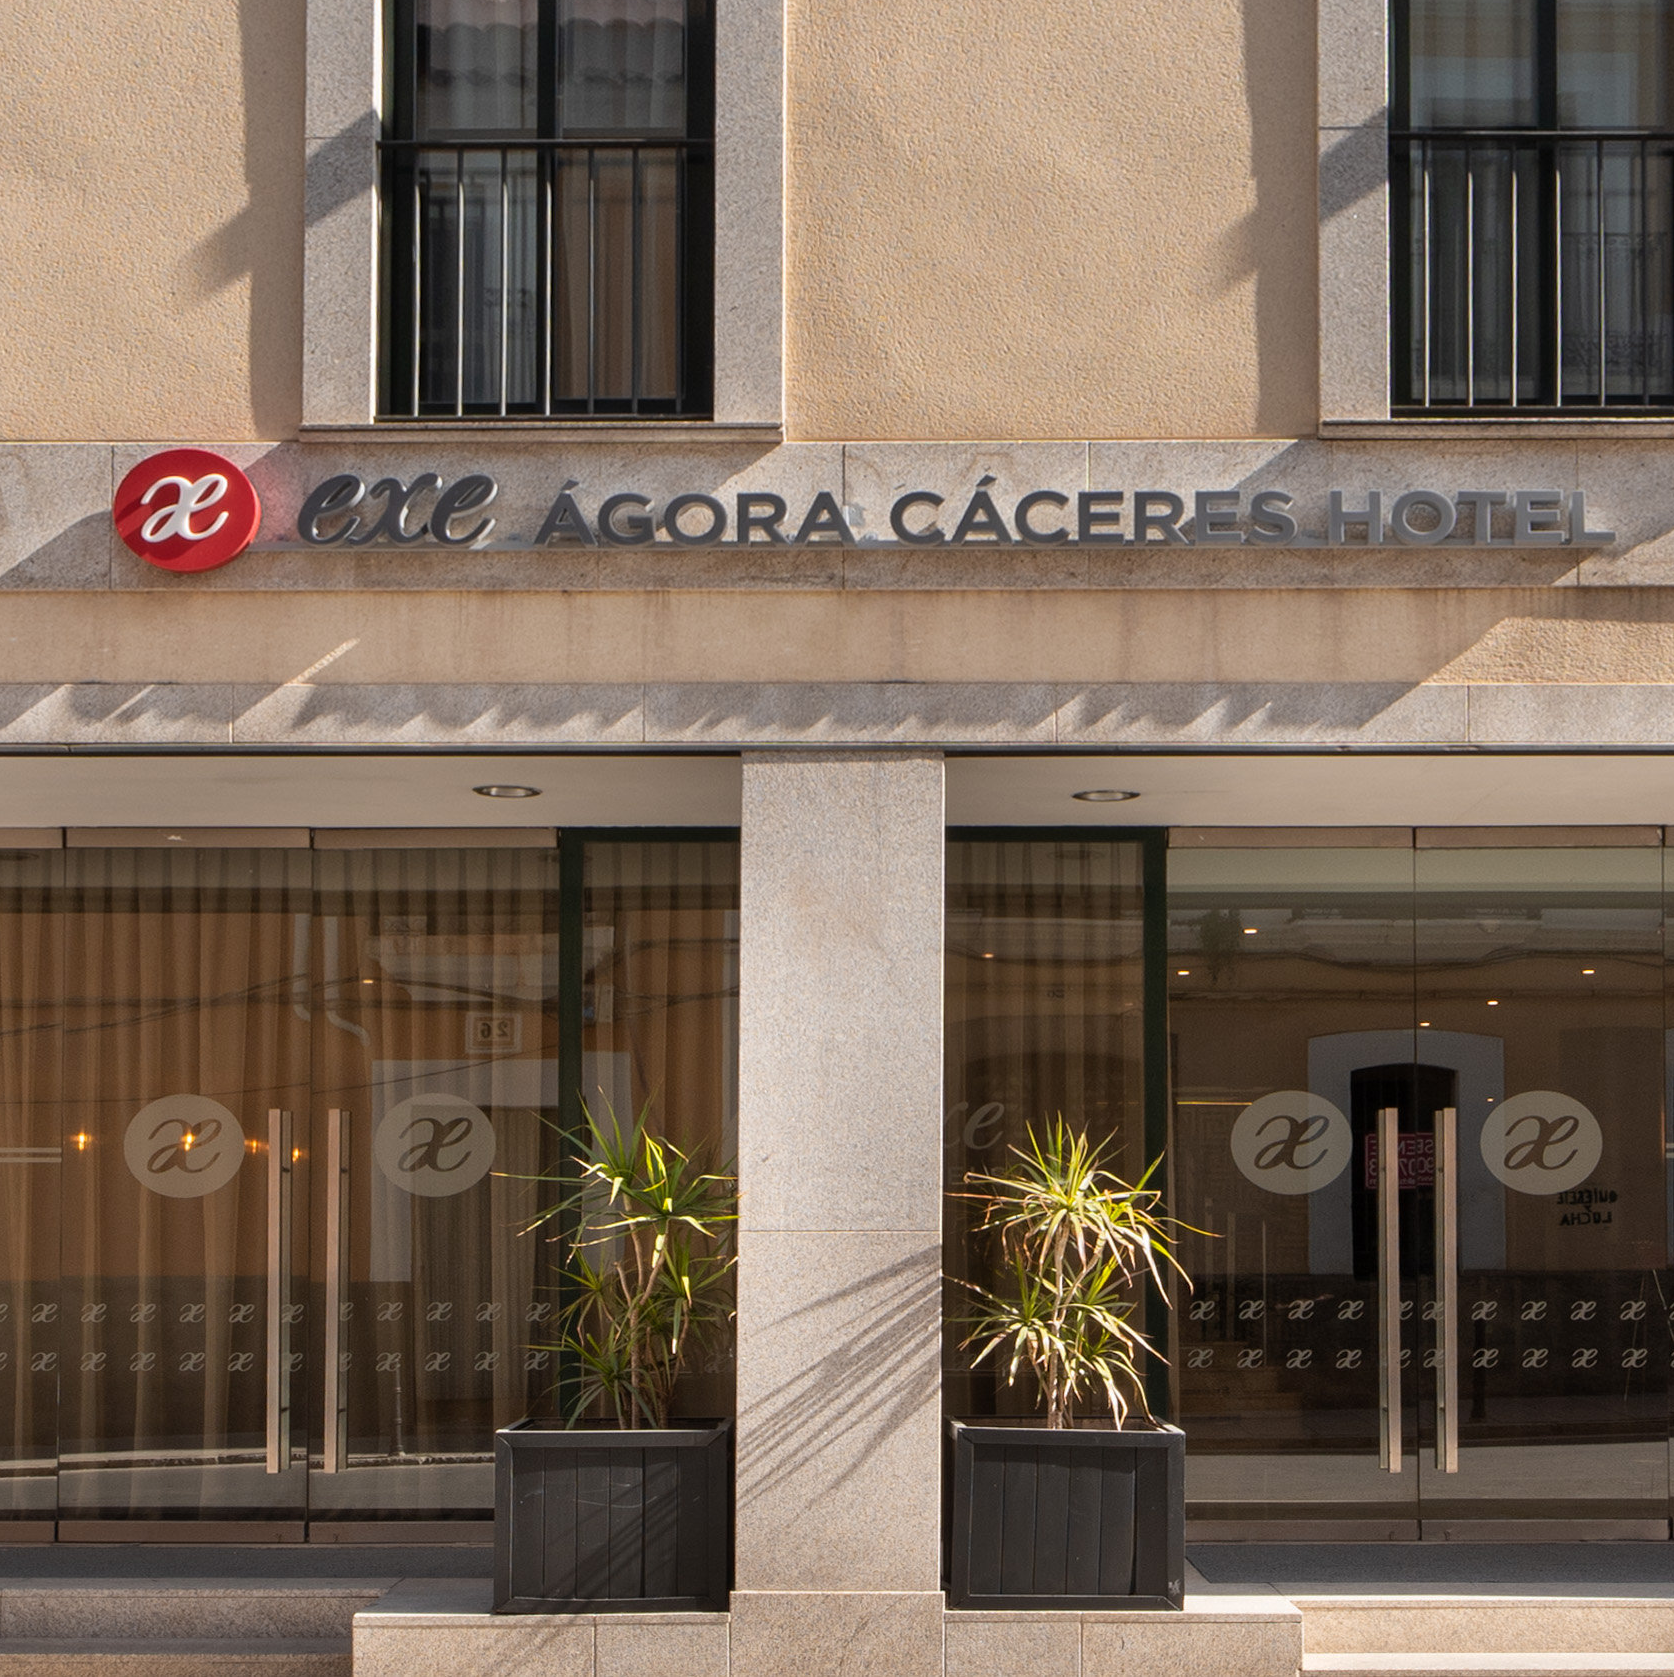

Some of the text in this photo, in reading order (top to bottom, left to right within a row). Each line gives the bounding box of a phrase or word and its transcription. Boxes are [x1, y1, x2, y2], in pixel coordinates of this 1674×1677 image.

[297, 472, 499, 547] exe
[533, 478, 857, 548] ÁGORA
[889, 474, 1299, 548] CÁCERES
[1328, 489, 1617, 547] HOTEL
